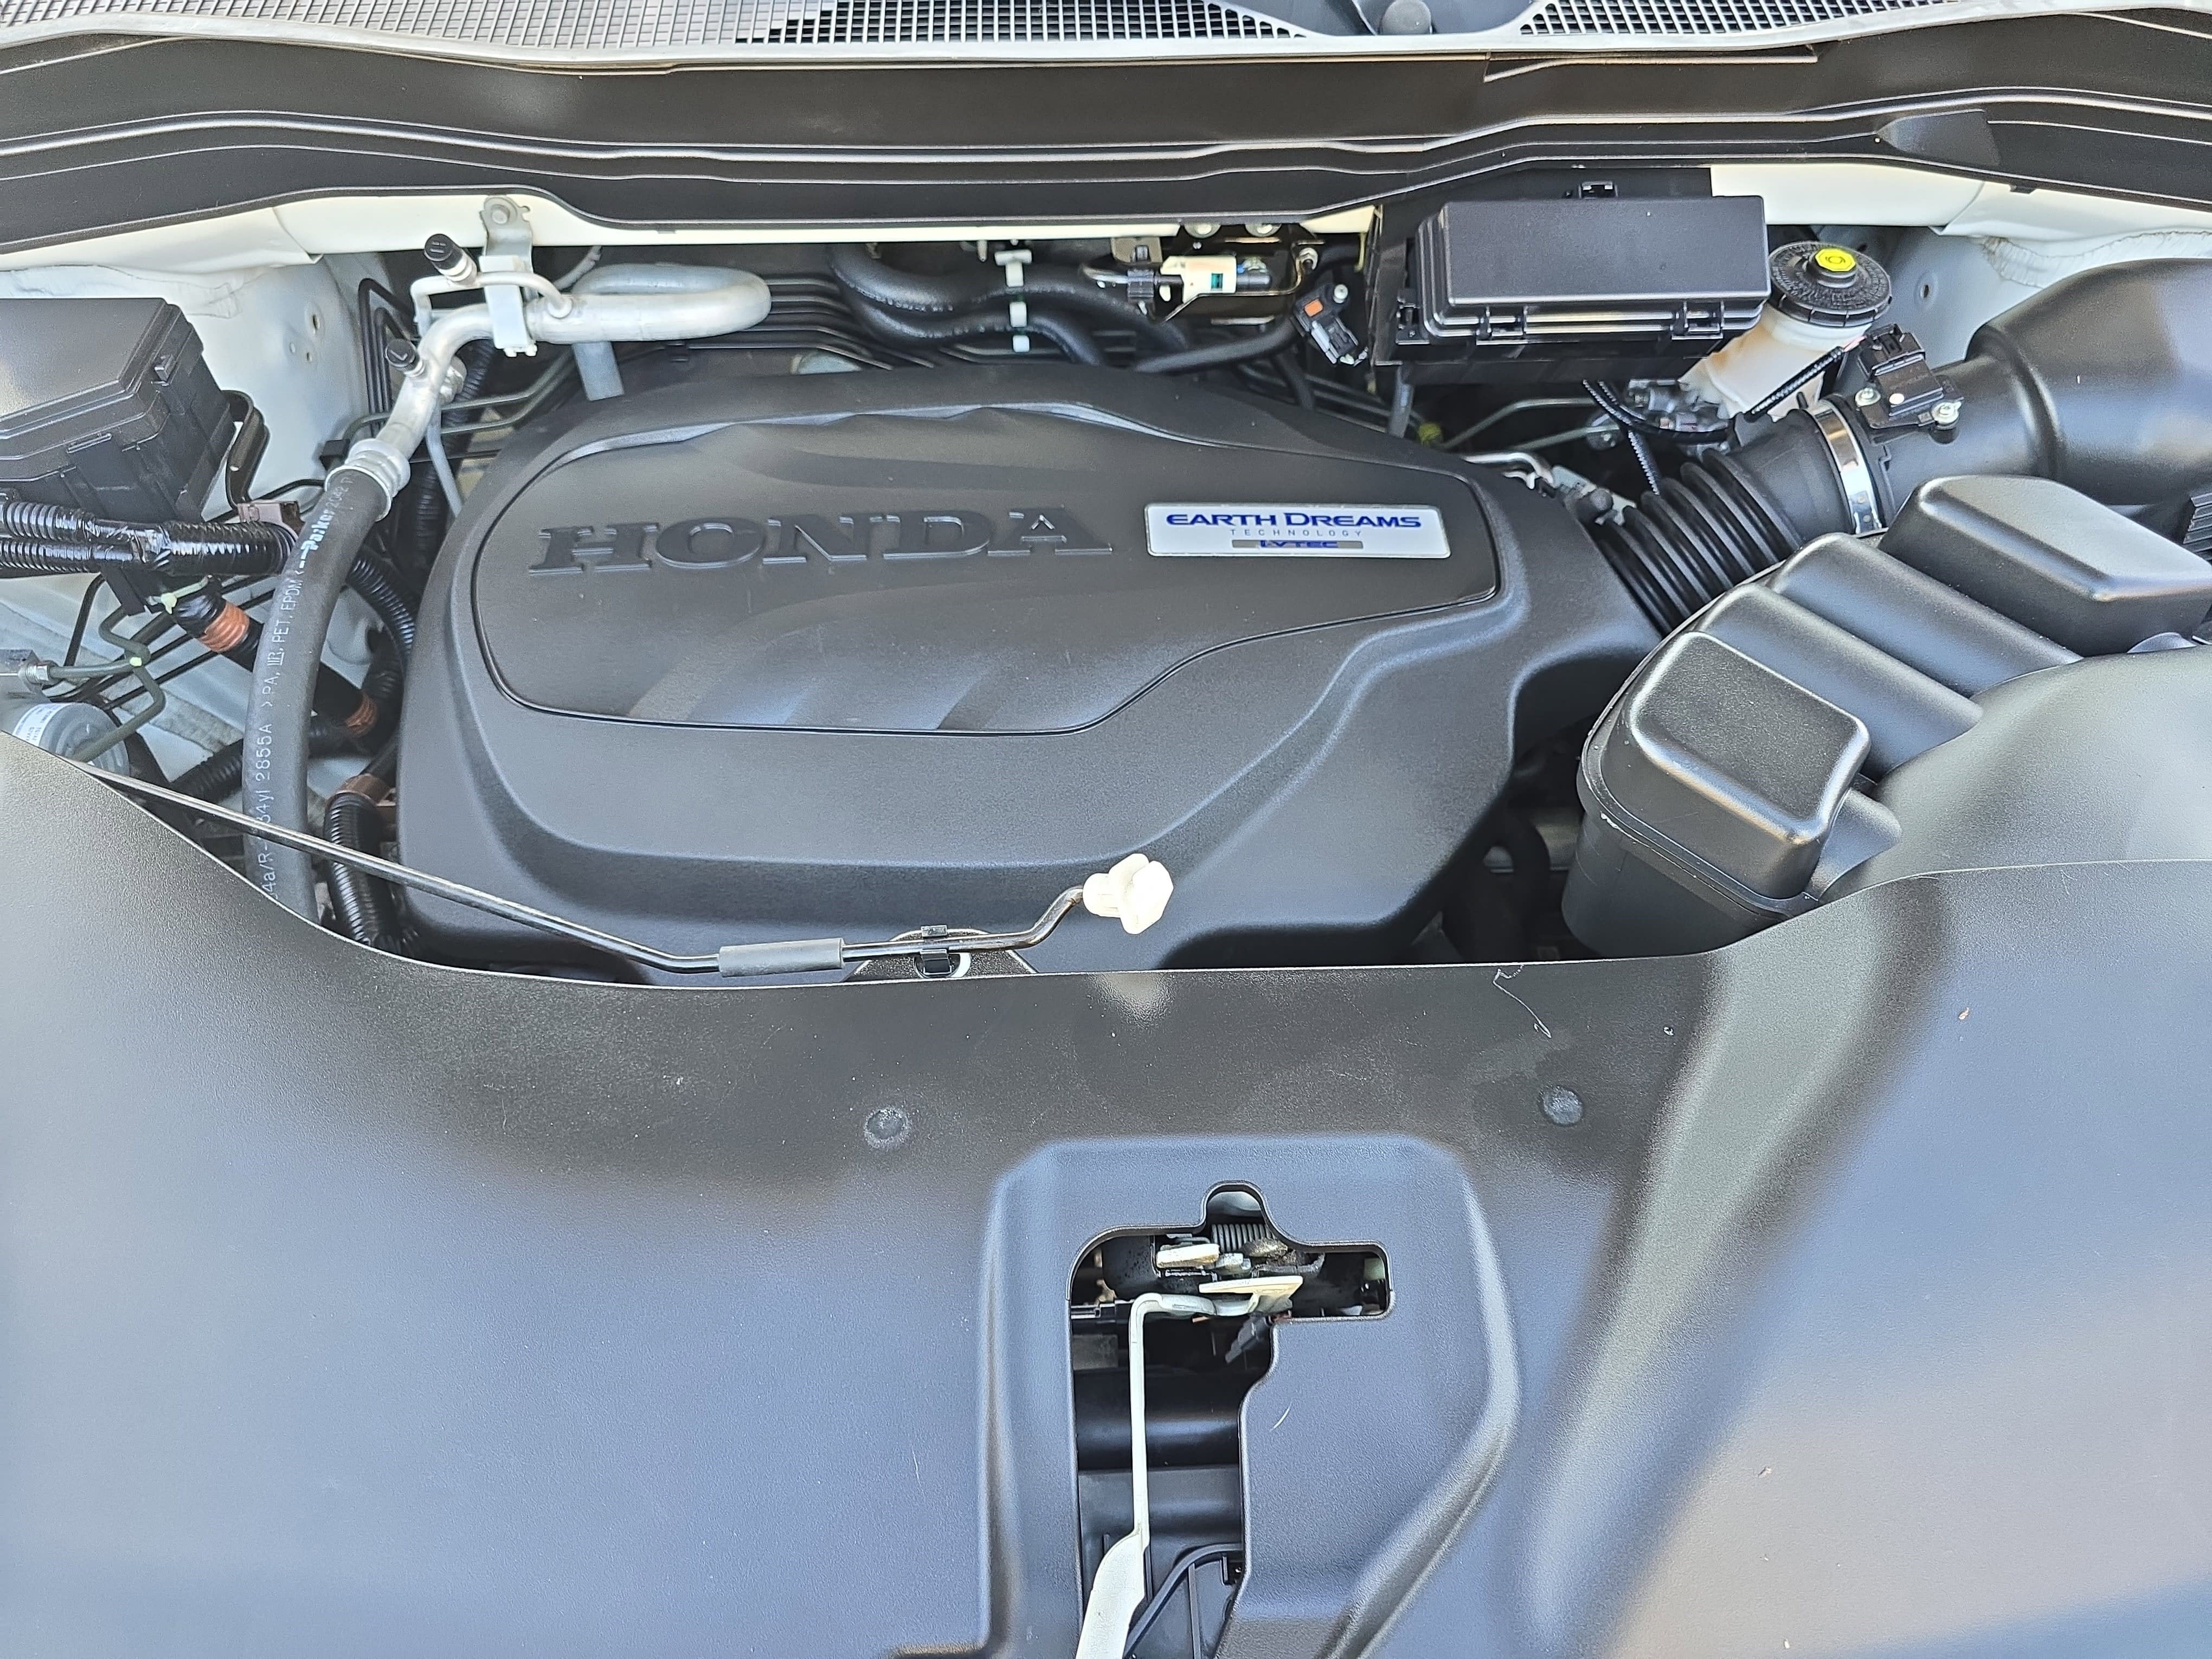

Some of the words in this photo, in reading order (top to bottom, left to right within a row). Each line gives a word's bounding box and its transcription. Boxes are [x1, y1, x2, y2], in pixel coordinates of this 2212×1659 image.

[528, 506, 1114, 576] HONDA
[1166, 514, 1277, 526] EARTH
[1283, 513, 1422, 528] DREAMS
[1230, 529, 1362, 537] TECHNOLOGY
[255, 723, 272, 781] 2855A
[300, 509, 336, 550] Parker
